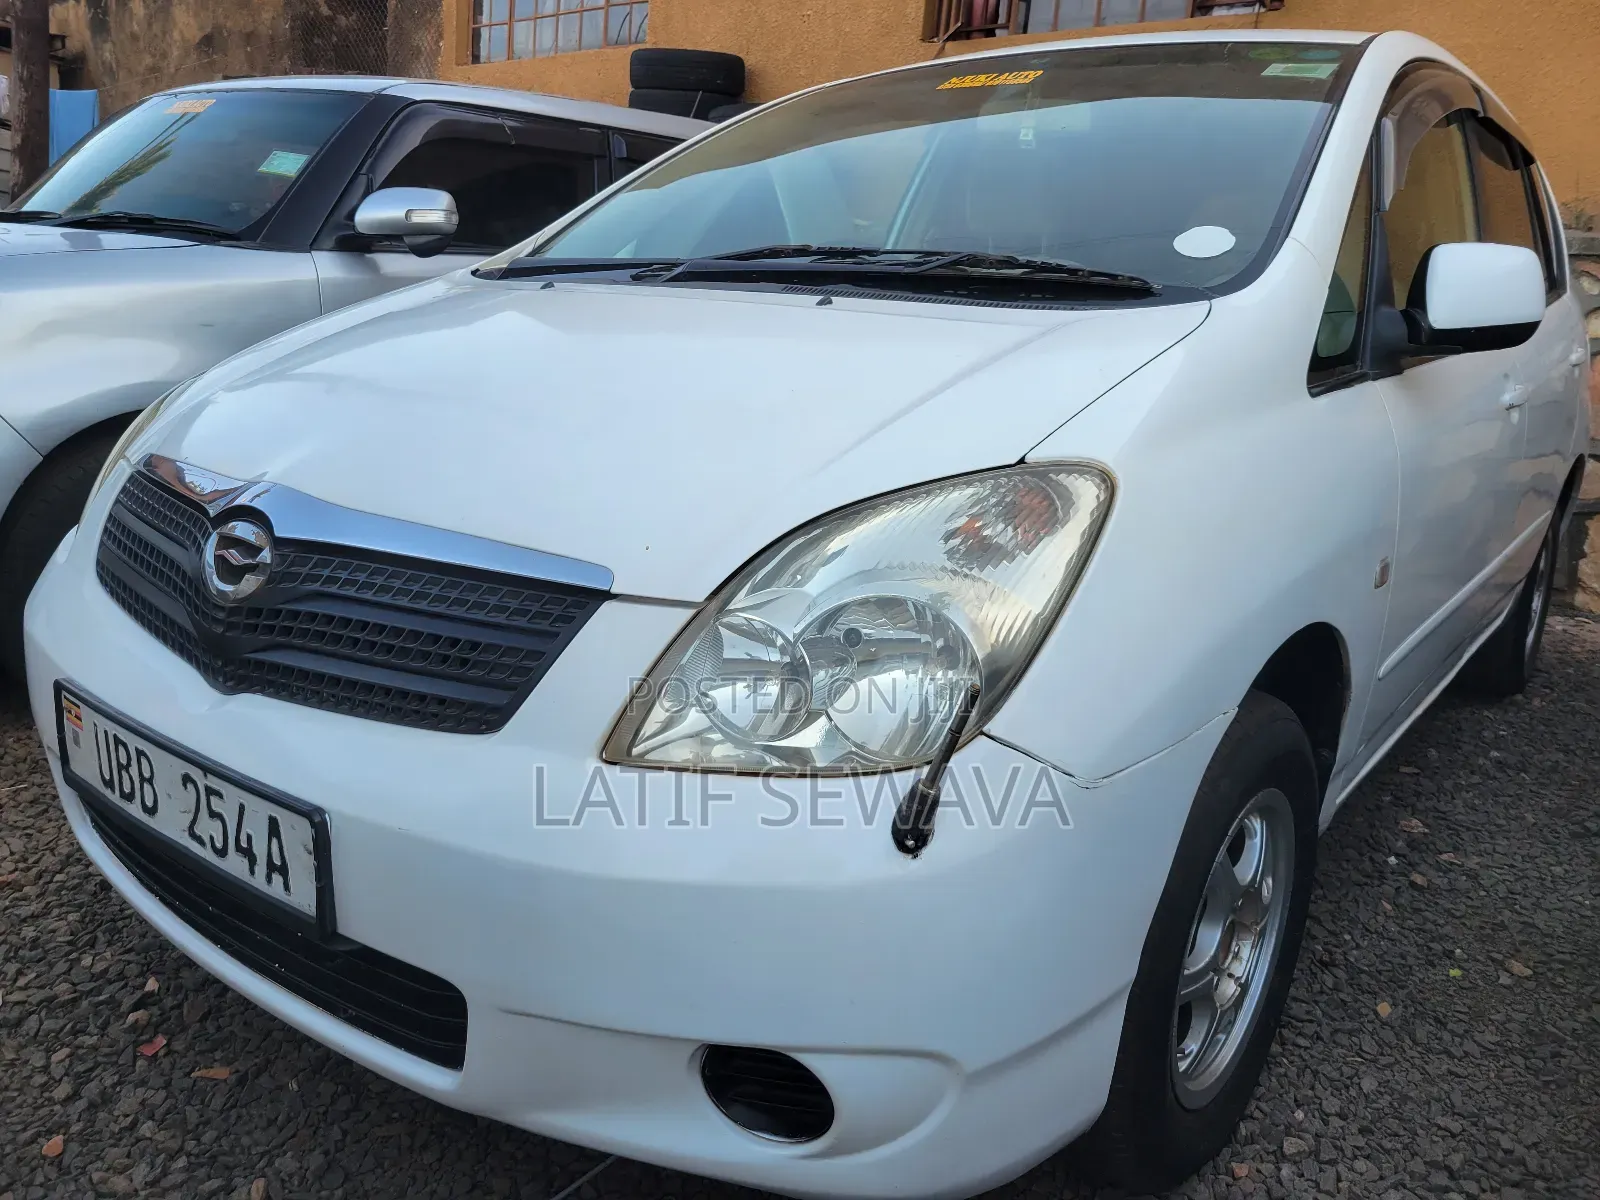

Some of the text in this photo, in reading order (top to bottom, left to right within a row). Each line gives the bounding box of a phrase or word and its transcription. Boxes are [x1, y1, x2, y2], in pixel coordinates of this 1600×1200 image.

[998, 70, 1044, 80] AUTO
[92, 721, 292, 895] UBB 254A
